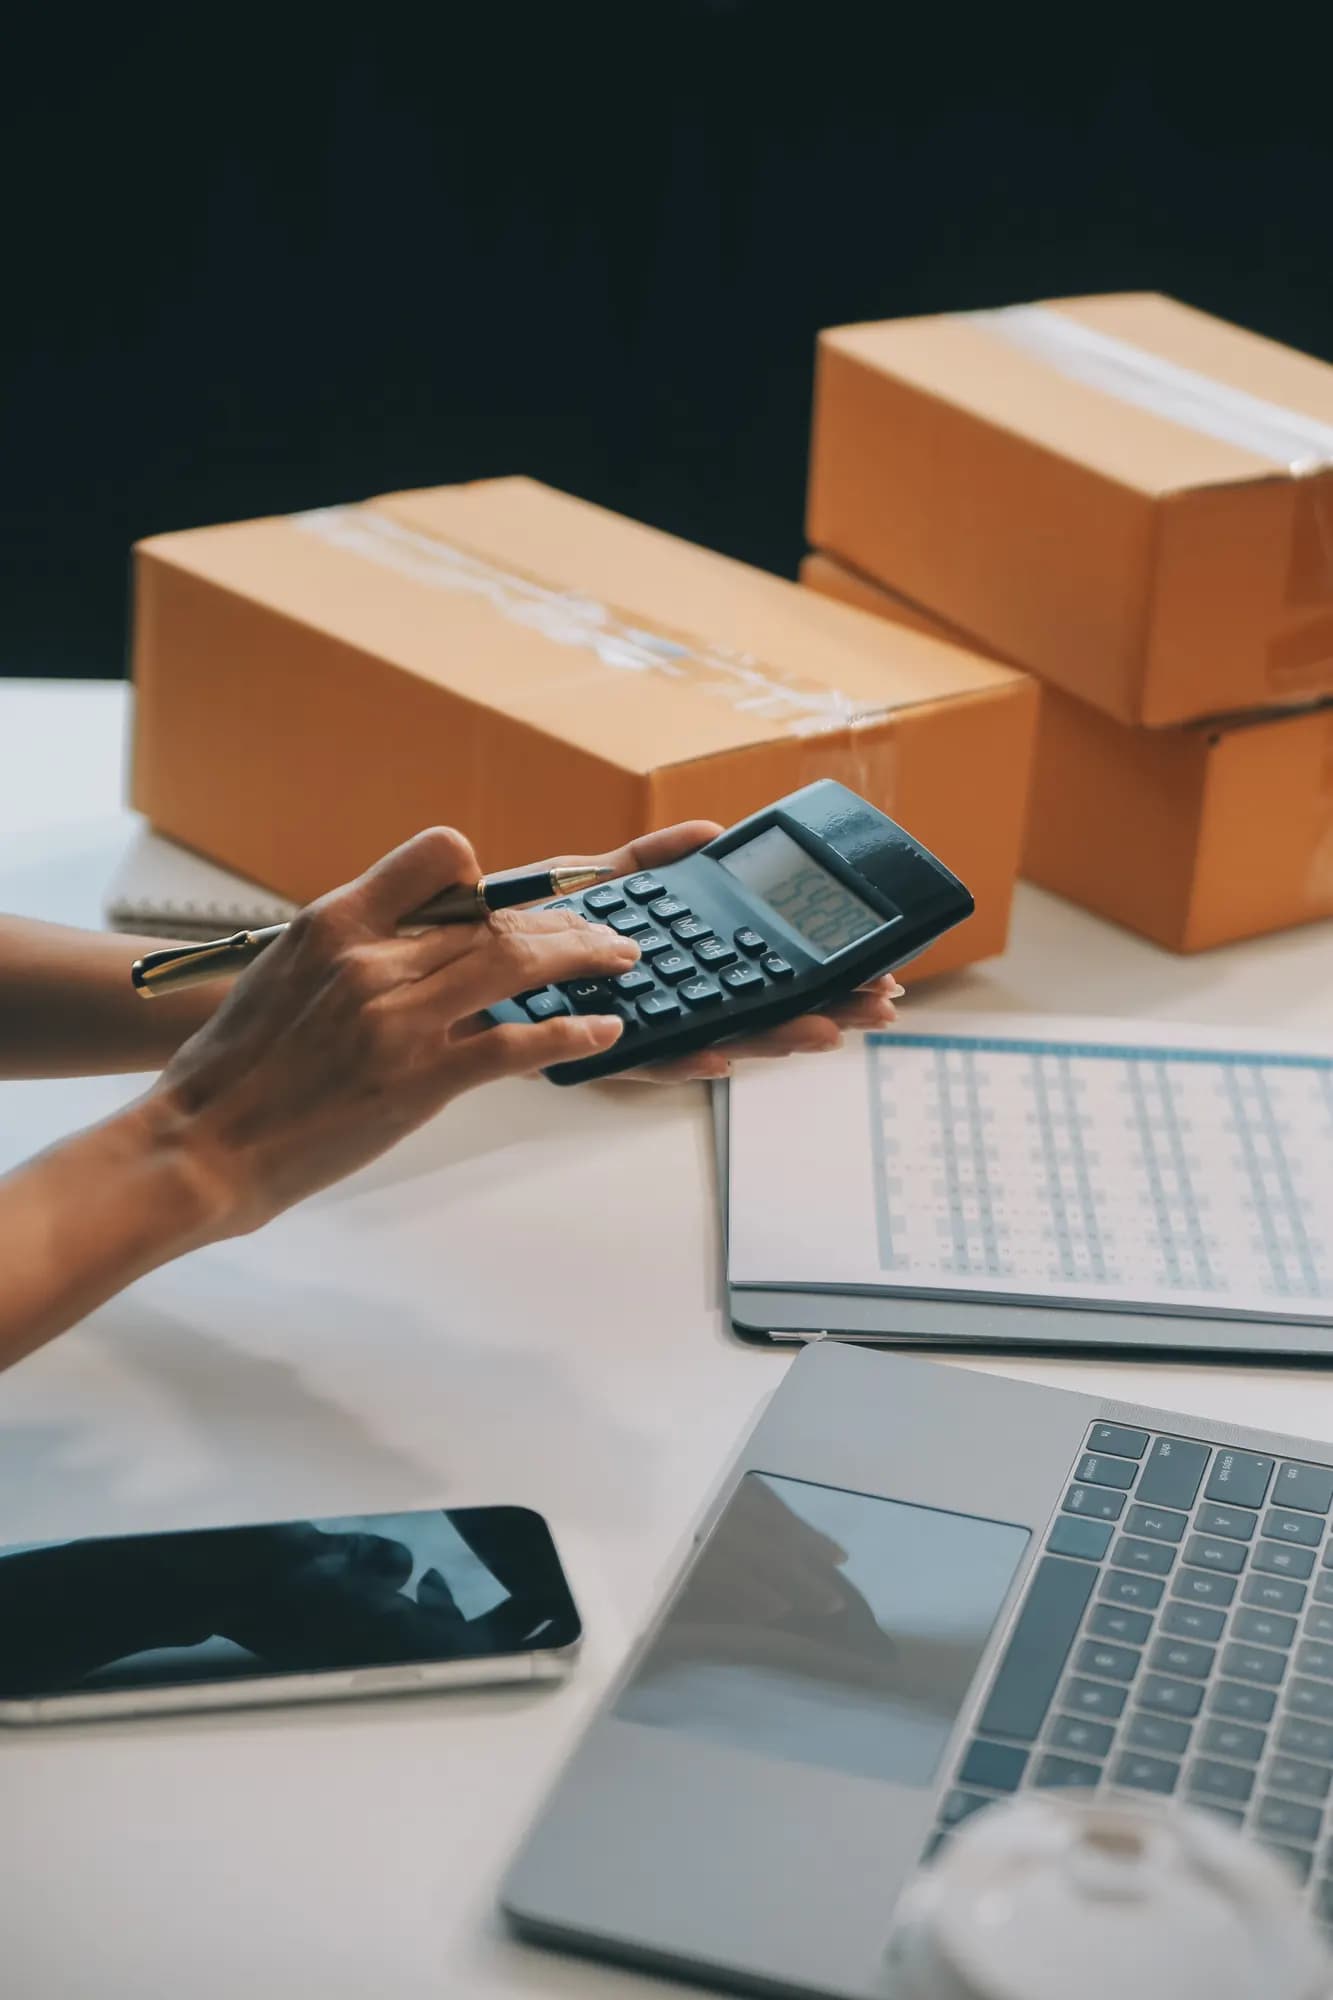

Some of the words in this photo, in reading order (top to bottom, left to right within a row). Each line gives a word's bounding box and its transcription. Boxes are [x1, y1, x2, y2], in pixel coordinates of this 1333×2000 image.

[656, 897, 679, 914] MR
[621, 914, 639, 923] 7
[639, 935, 658, 946] 8
[700, 939, 722, 957] M+
[660, 956, 681, 968] 9
[620, 970, 641, 982] 6
[576, 984, 598, 996] 3
[1159, 1442, 1171, 1457] shift
[1144, 1518, 1161, 1529] Z
[1213, 1517, 1231, 1527] A
